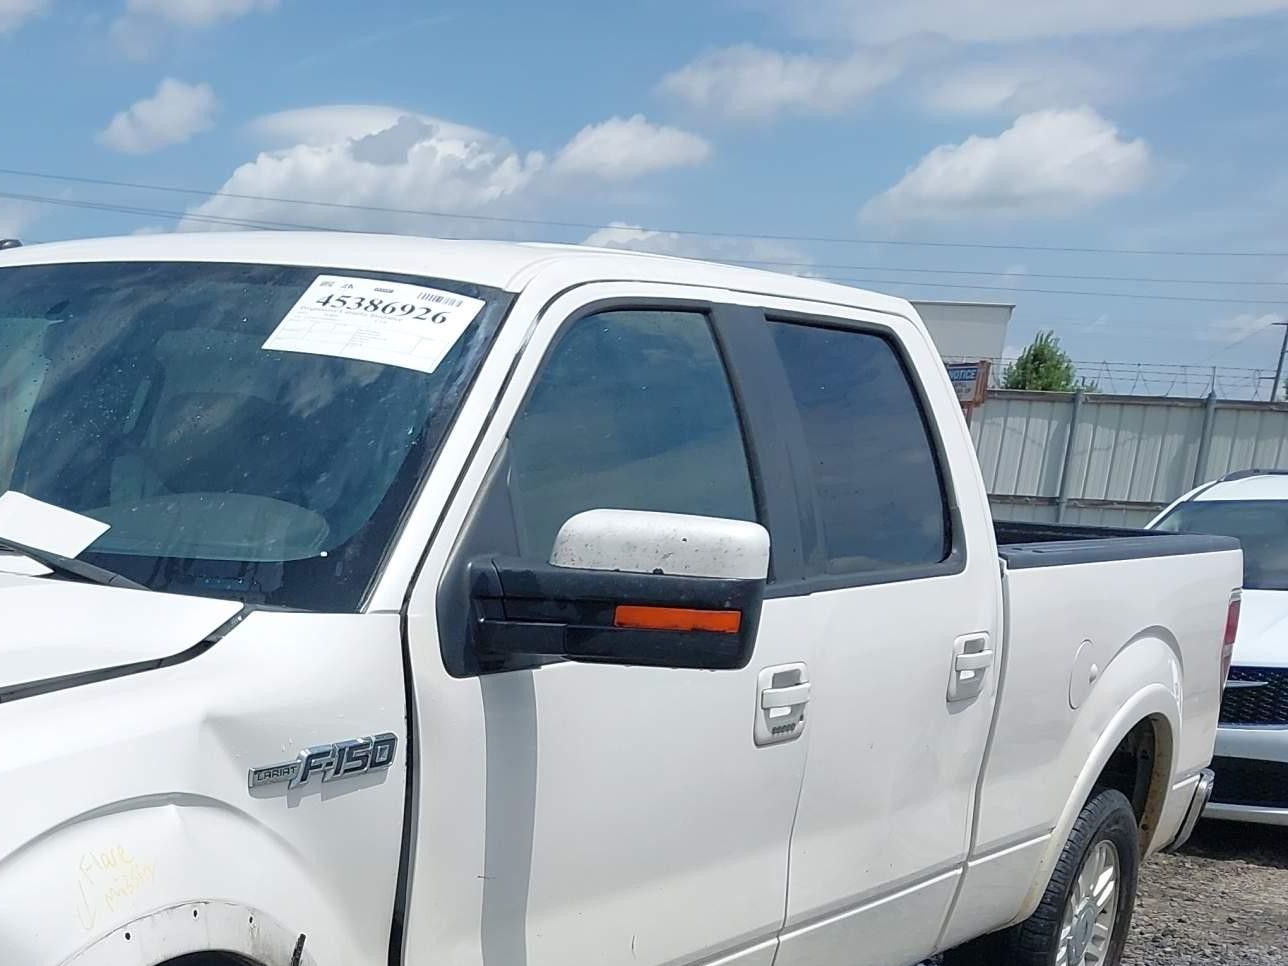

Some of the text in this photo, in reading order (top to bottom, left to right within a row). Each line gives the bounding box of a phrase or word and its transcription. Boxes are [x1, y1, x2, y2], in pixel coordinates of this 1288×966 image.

[316, 294, 452, 325] 45386926
[257, 731, 399, 790] LARIAT F-150
